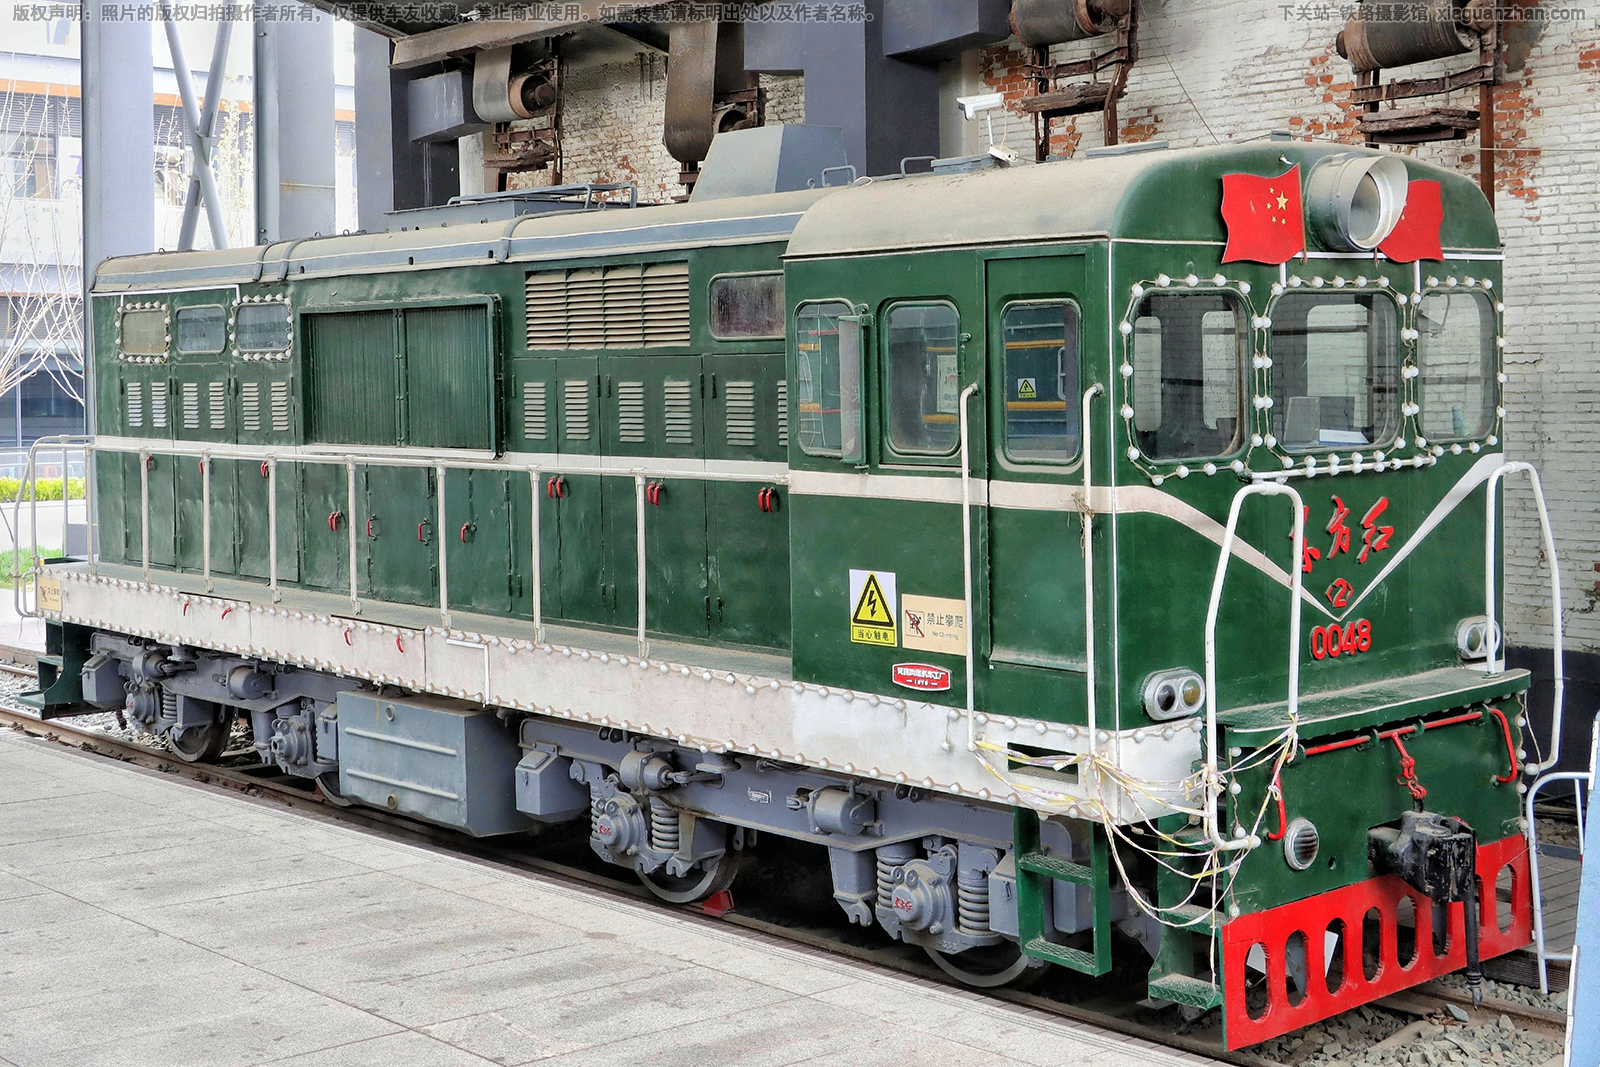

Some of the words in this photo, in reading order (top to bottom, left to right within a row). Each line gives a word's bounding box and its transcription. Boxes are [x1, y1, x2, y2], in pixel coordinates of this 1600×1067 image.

[926, 612, 964, 629] 禁止攀爬
[857, 628, 889, 641] 当心触电
[1311, 618, 1372, 660] 0048
